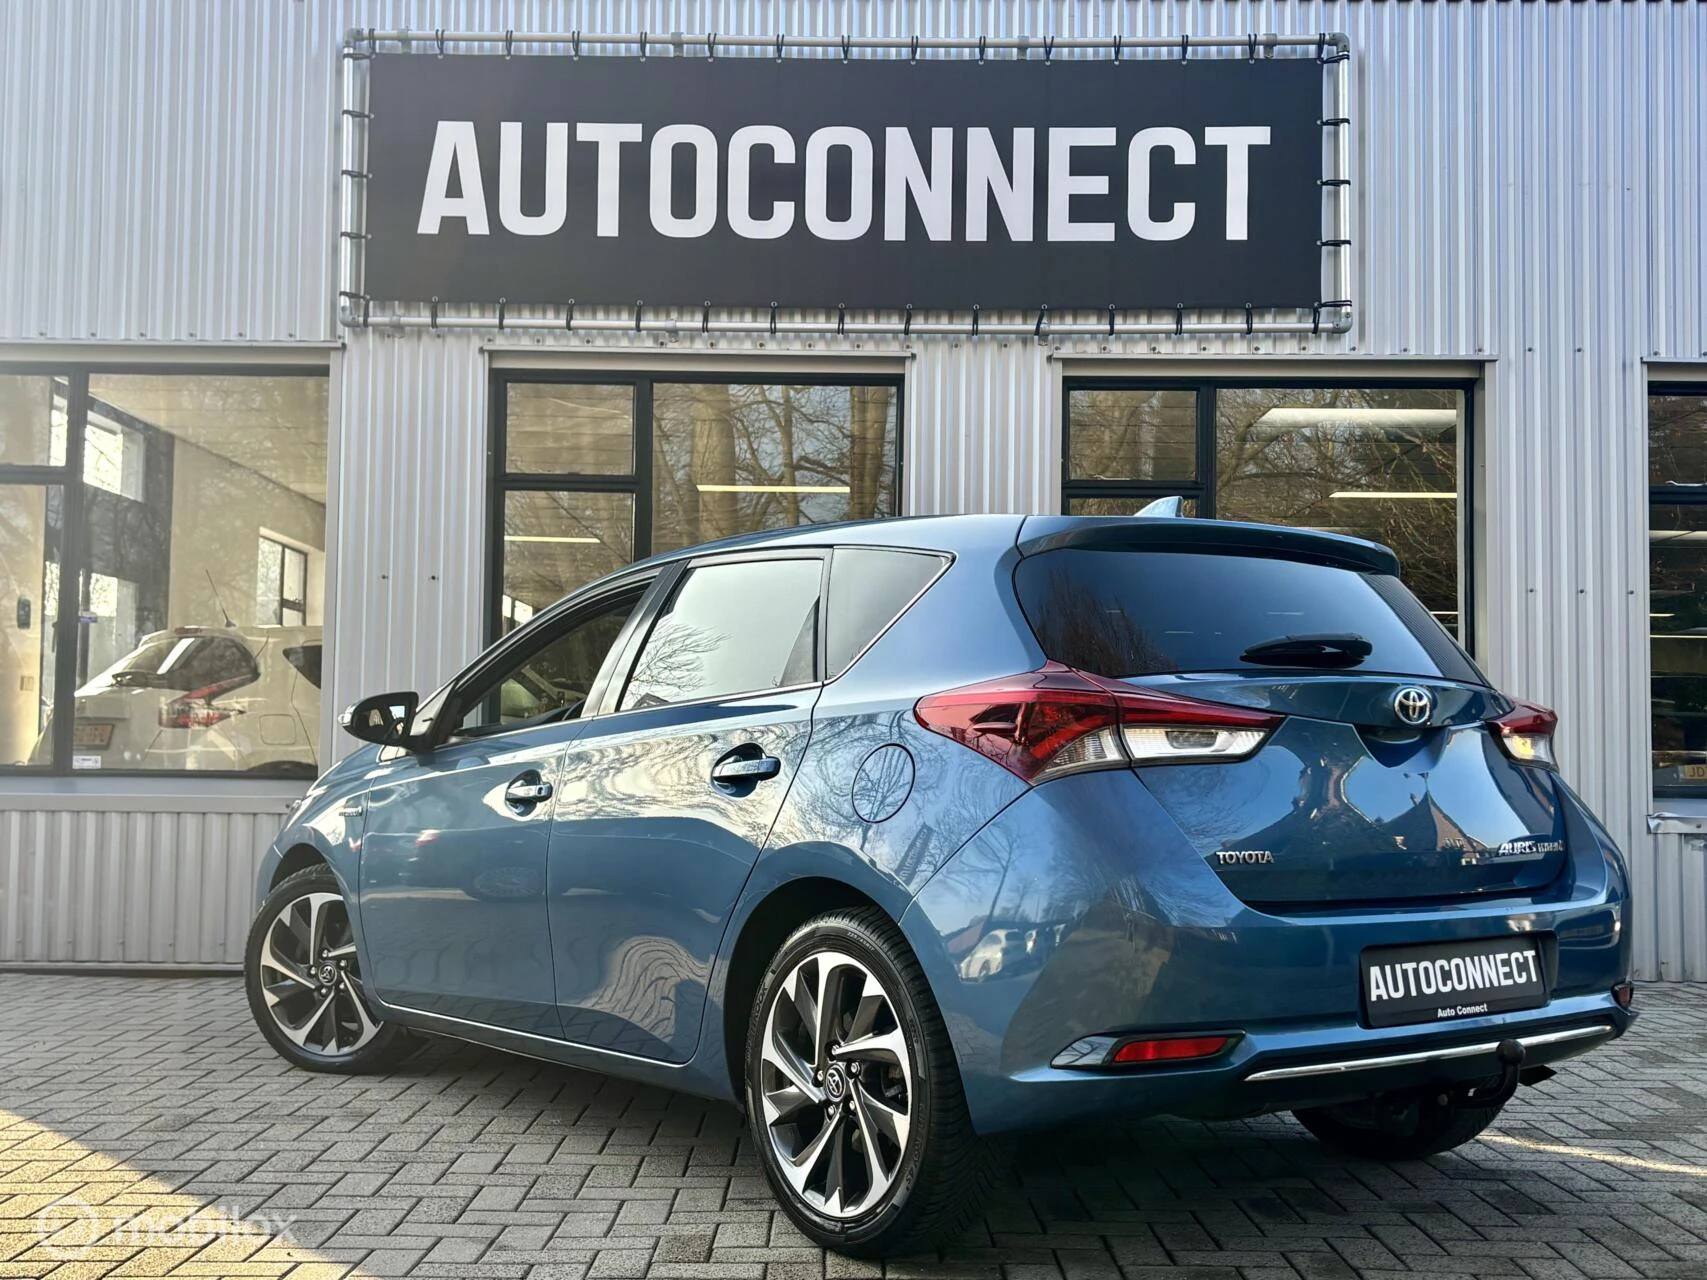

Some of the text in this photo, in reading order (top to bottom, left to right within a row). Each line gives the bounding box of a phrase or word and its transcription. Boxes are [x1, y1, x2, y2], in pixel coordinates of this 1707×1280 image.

[417, 121, 1271, 241] AUTOCONNECT
[1688, 766, 1707, 777] JD
[1498, 841, 1536, 855] AURIS
[1216, 850, 1274, 865] TOYOTA
[1369, 950, 1537, 1001] AUTOCONNECT
[1437, 1003, 1488, 1018] Auto Connect
